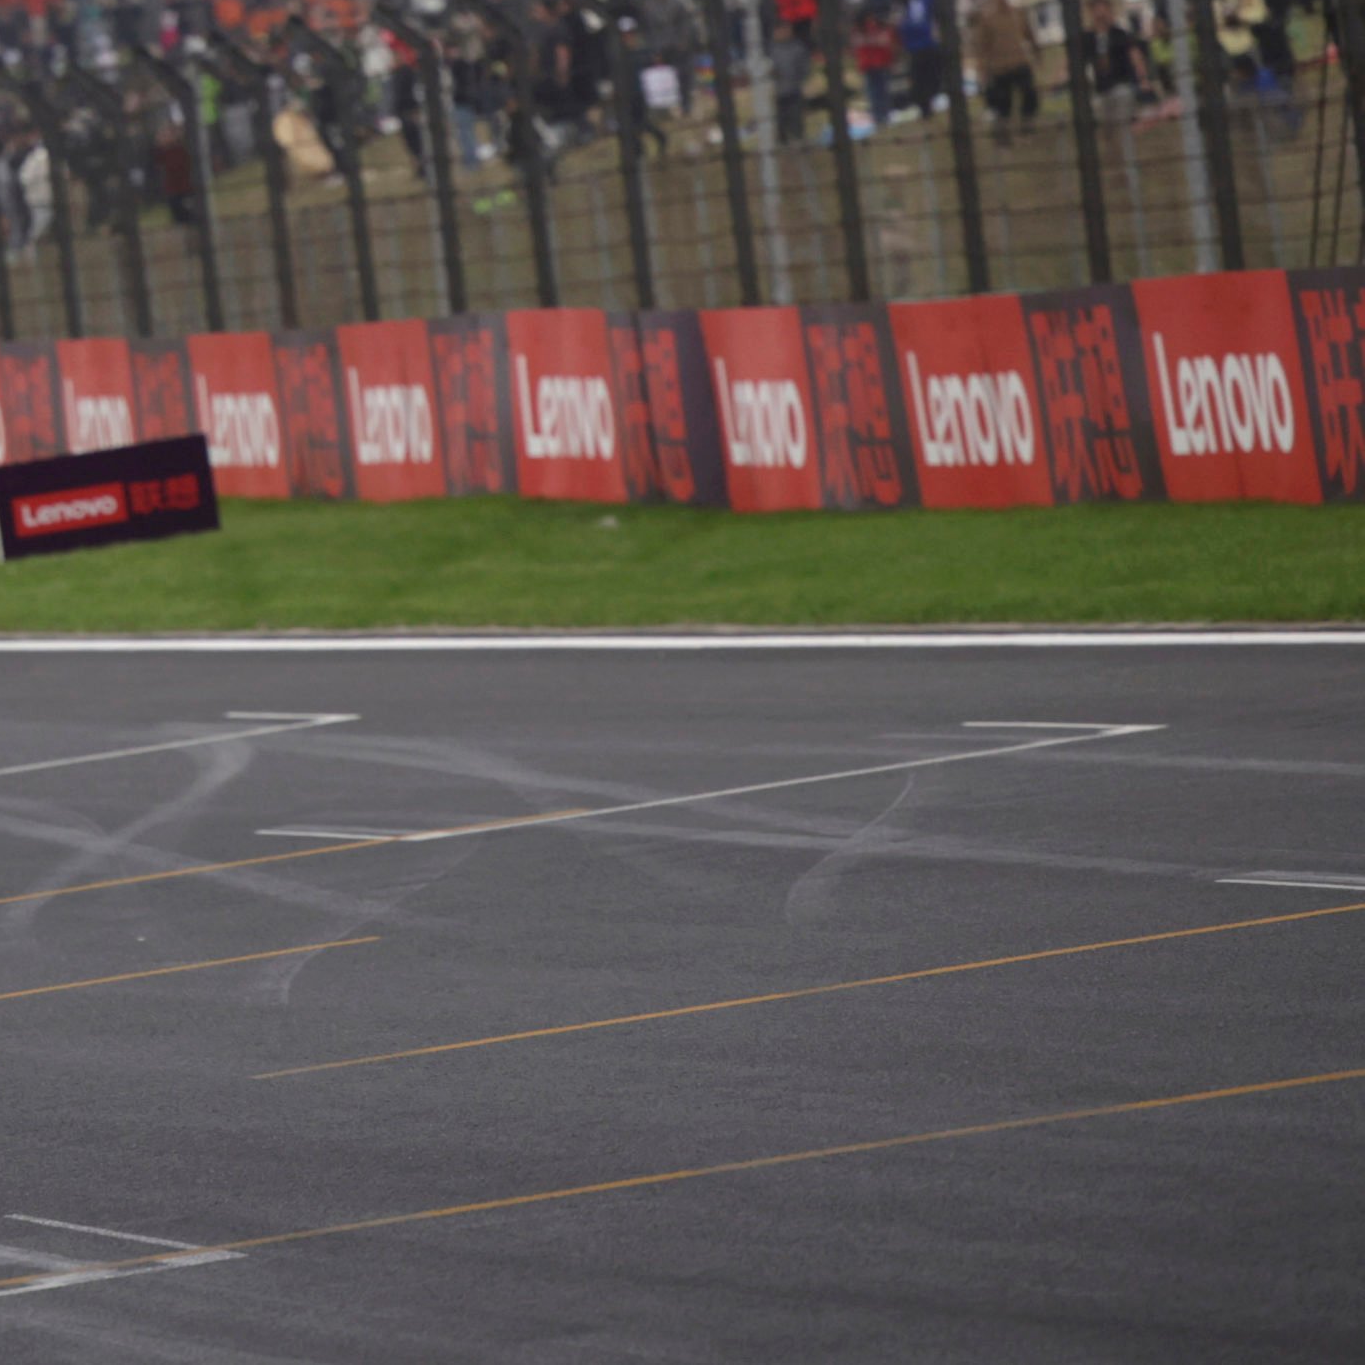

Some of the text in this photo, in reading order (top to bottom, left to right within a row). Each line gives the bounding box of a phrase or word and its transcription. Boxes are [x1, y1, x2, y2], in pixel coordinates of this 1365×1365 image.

[516, 353, 616, 461] Lenovo
[715, 356, 807, 468] Lenovo
[906, 350, 1036, 466] Lenovo
[1152, 331, 1295, 455] Lenovo
[21, 494, 119, 528] Lenovo
